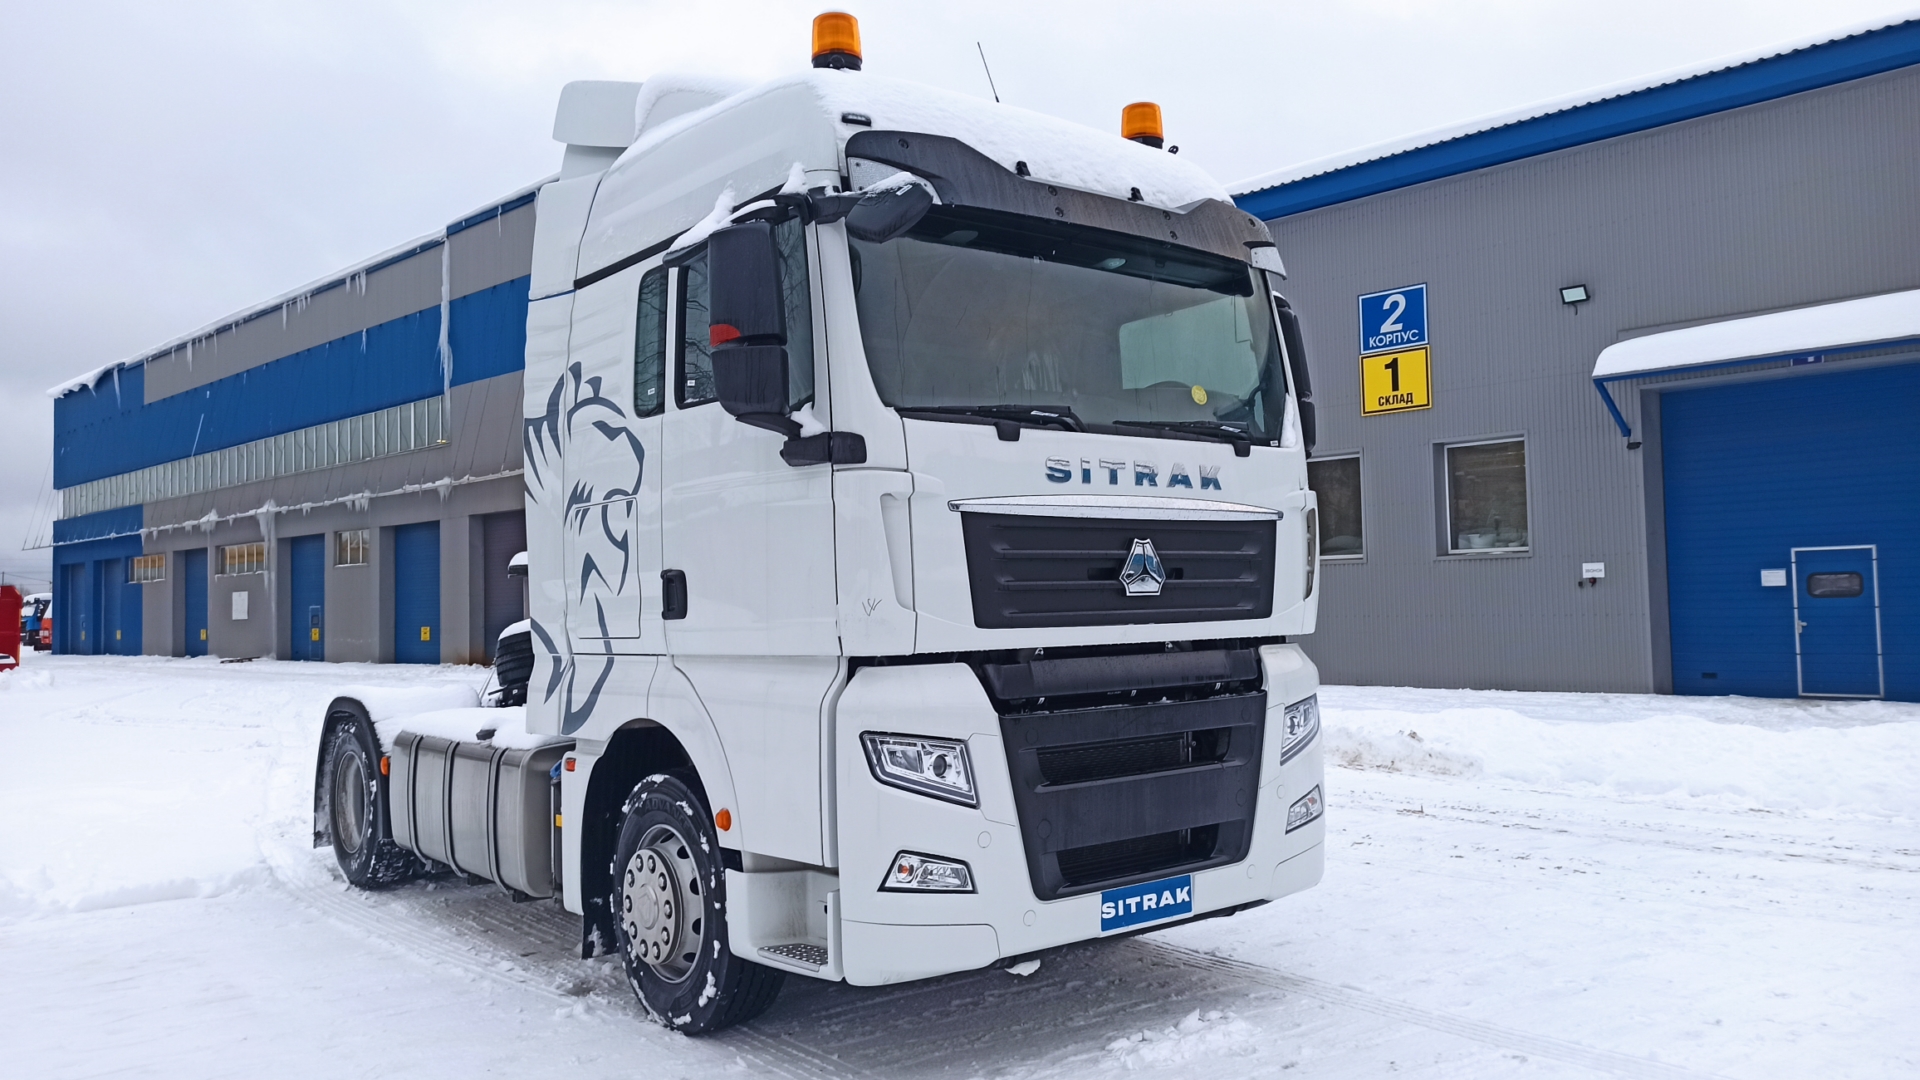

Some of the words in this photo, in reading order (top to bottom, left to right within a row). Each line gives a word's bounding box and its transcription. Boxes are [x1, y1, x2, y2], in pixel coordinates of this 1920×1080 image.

[1380, 293, 1407, 334] 2
[1369, 329, 1420, 348] КОРПУС
[1384, 357, 1400, 392] 1
[1378, 392, 1414, 407] СКЛАД
[1045, 454, 1222, 491] SITRAK
[1101, 886, 1190, 919] SITRAK
